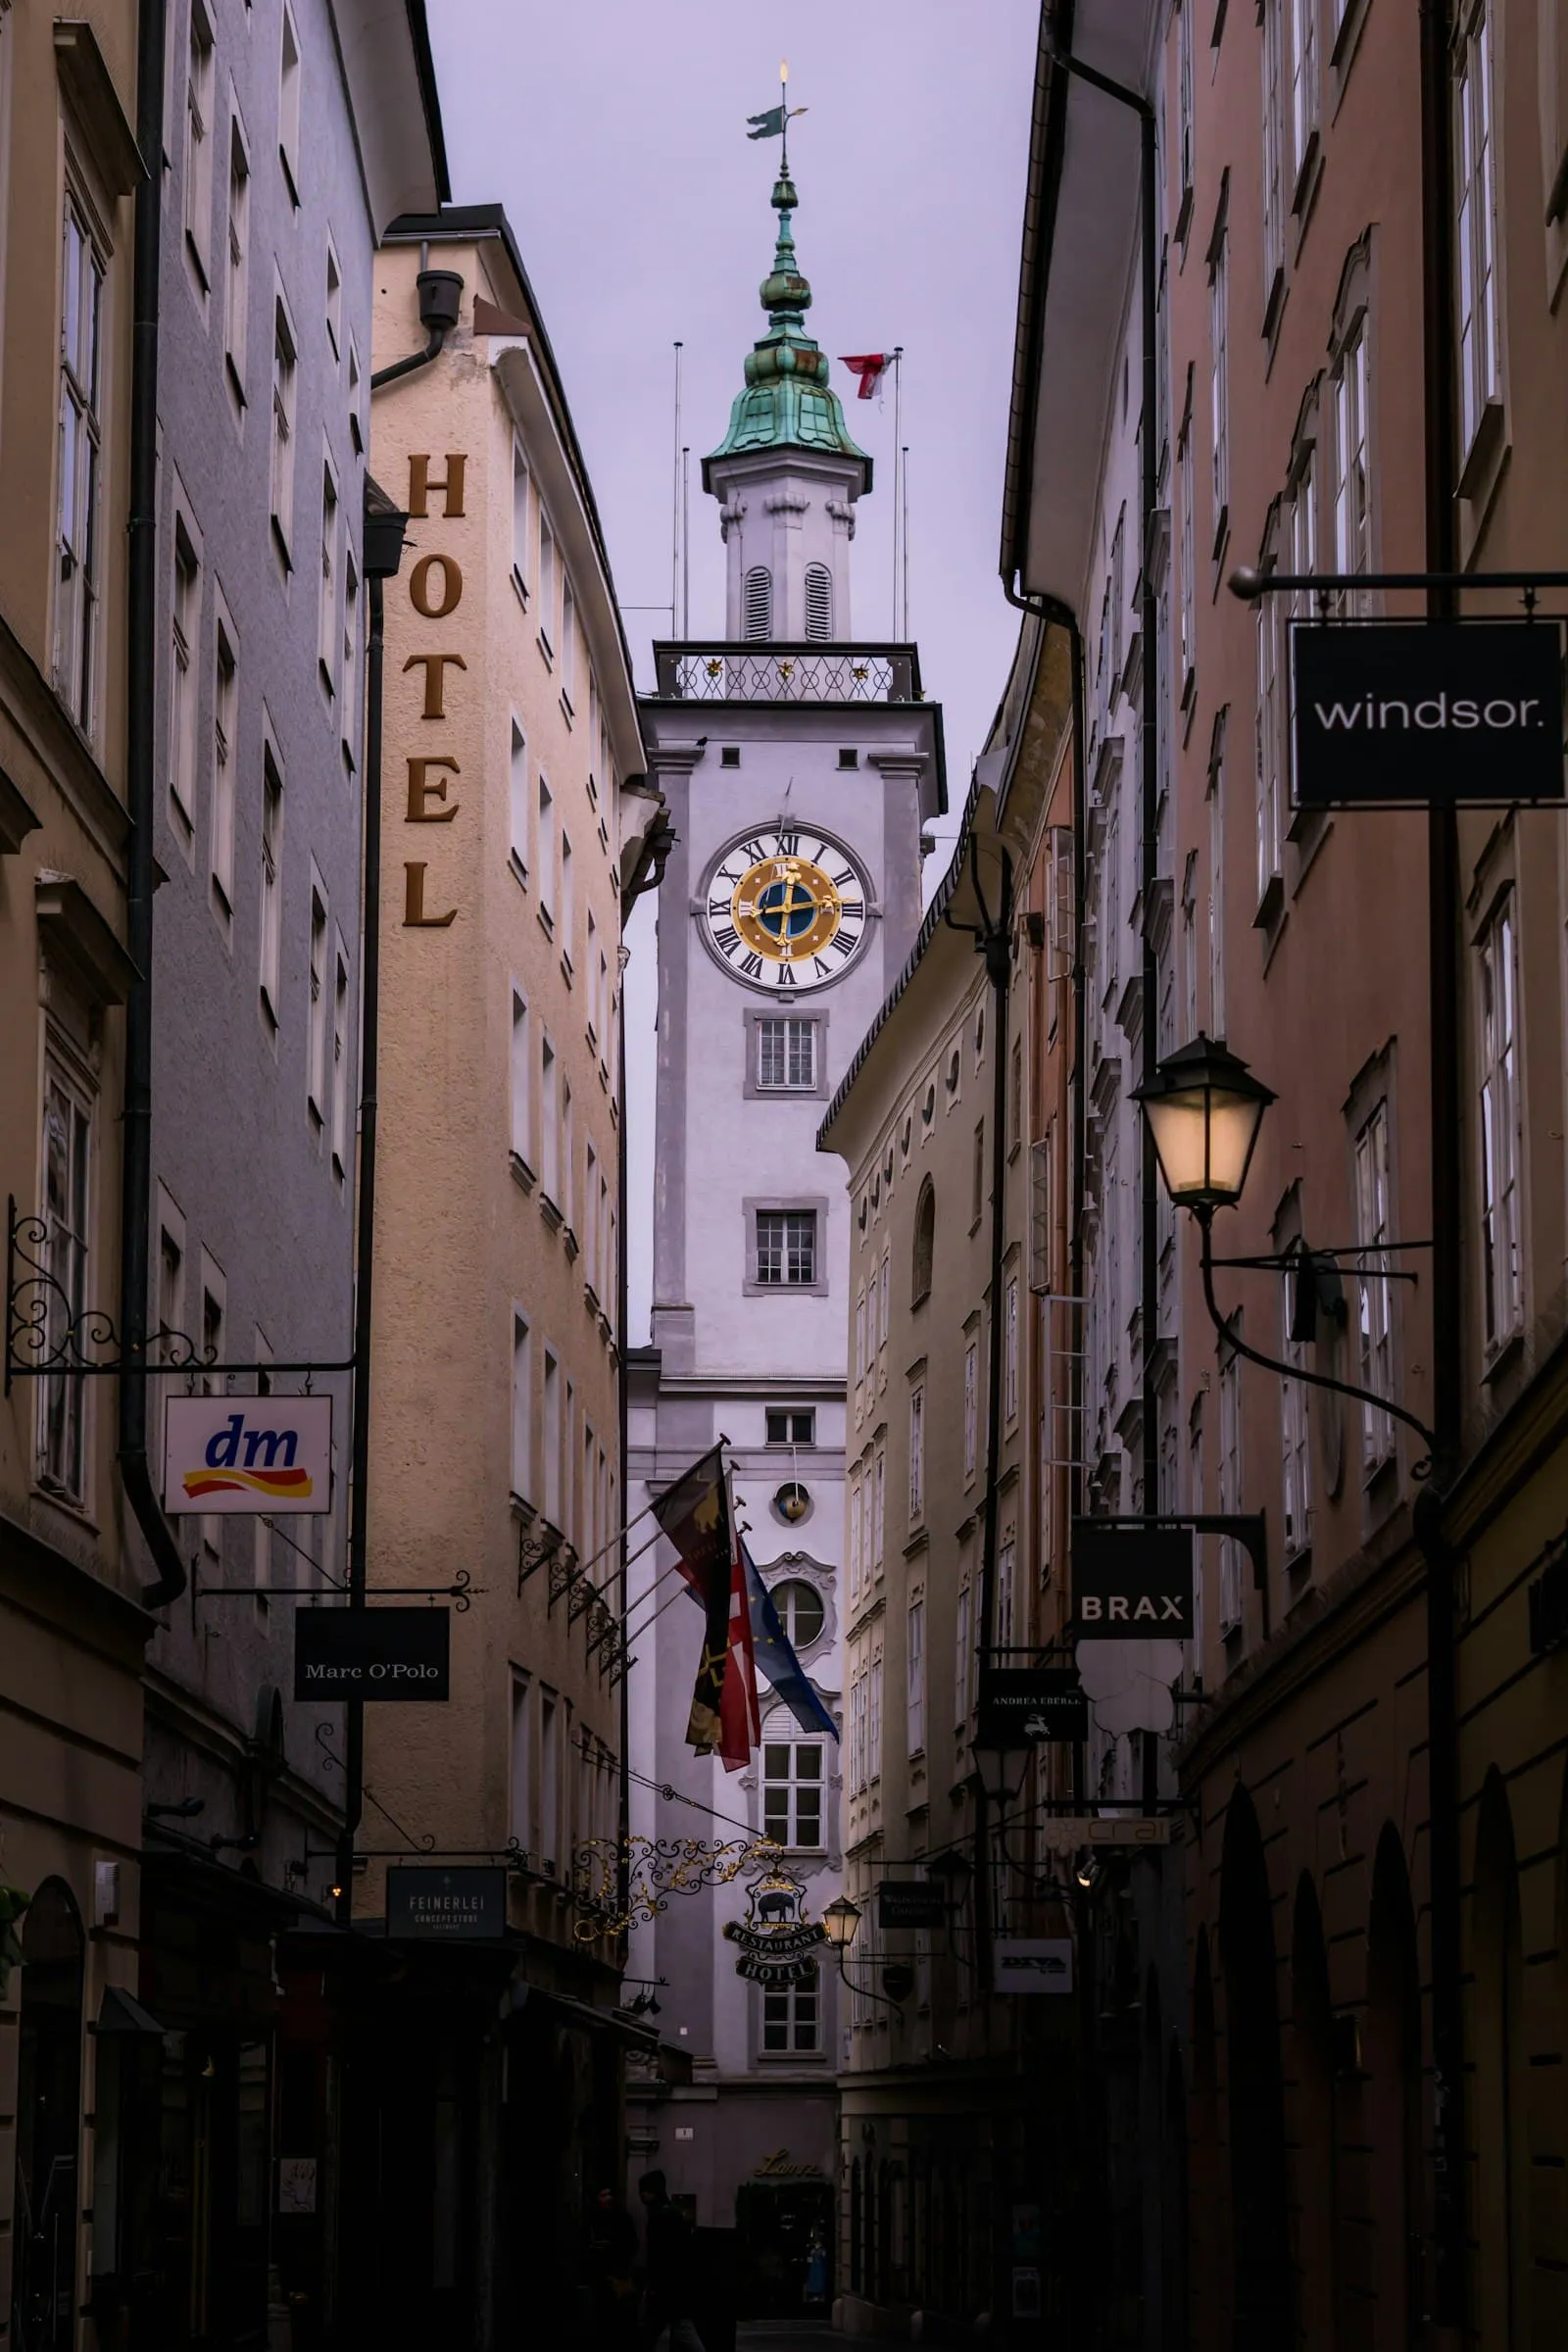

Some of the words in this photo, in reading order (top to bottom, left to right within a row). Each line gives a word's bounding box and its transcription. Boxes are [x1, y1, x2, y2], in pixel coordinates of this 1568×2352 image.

[402, 454, 469, 927] HOTEL
[1313, 691, 1545, 730] windsor.
[205, 1414, 298, 1468] dm
[1081, 1594, 1185, 1622] BRAX
[305, 1663, 364, 1680] Marc
[368, 1663, 440, 1680] O'Polo
[992, 1696, 1038, 1706] ANDREA
[409, 1894, 485, 1911] FEINERLEI
[731, 1928, 820, 1950] RESTAURANT
[744, 1962, 807, 1981] HOTEL
